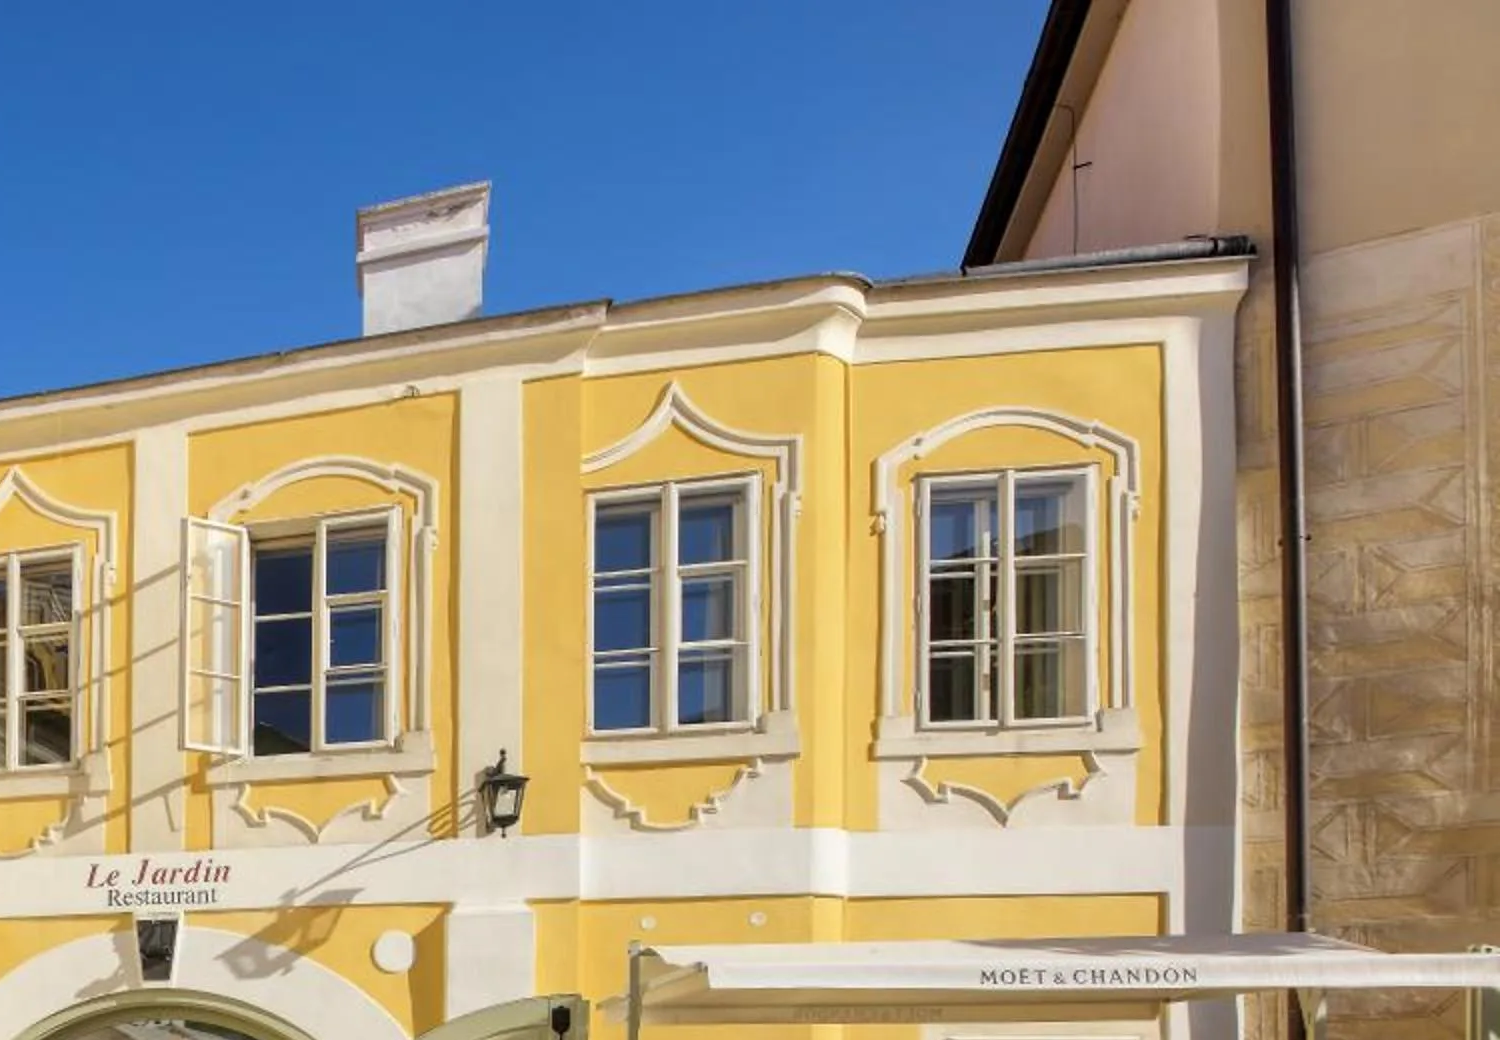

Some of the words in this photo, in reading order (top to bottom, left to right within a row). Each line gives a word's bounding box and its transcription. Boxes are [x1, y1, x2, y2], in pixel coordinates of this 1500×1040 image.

[86, 863, 120, 888] Le
[131, 859, 232, 886] Jardin
[107, 888, 218, 907] Restaurant
[1053, 971, 1067, 985] &
[1073, 967, 1198, 984] CHANDON
